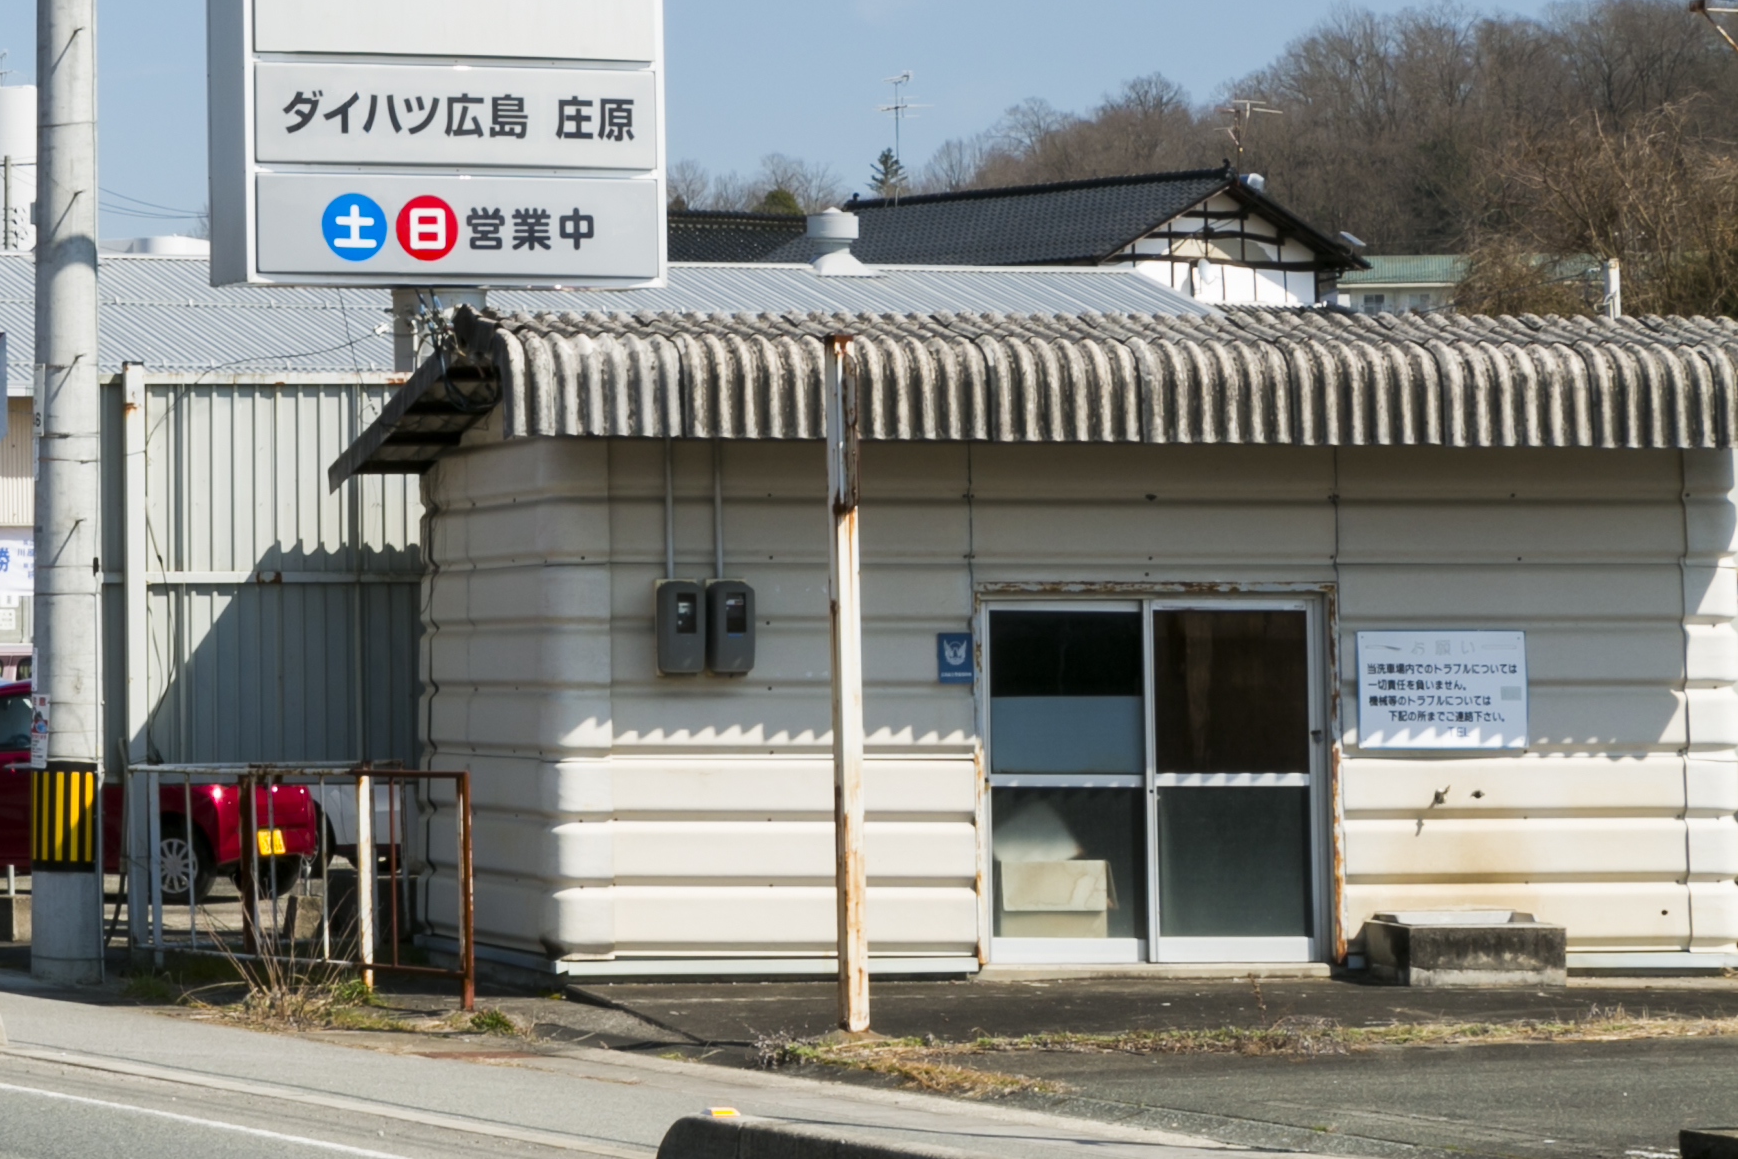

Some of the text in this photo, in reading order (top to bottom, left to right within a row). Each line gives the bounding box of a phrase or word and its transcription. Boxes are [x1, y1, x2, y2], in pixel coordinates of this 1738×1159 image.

[282, 89, 635, 142] ダイハツ広島 庄原
[1411, 640, 1476, 656] お願い
[1367, 663, 1518, 674] 当洗車場内でのトラブルについては
[1368, 679, 1467, 691] 一切責任を負いません。
[1369, 695, 1491, 707] 機械等のトラブルについては
[1389, 710, 1505, 723] 下記の所までご連絡下さい。
[1447, 726, 1470, 737] TEL
